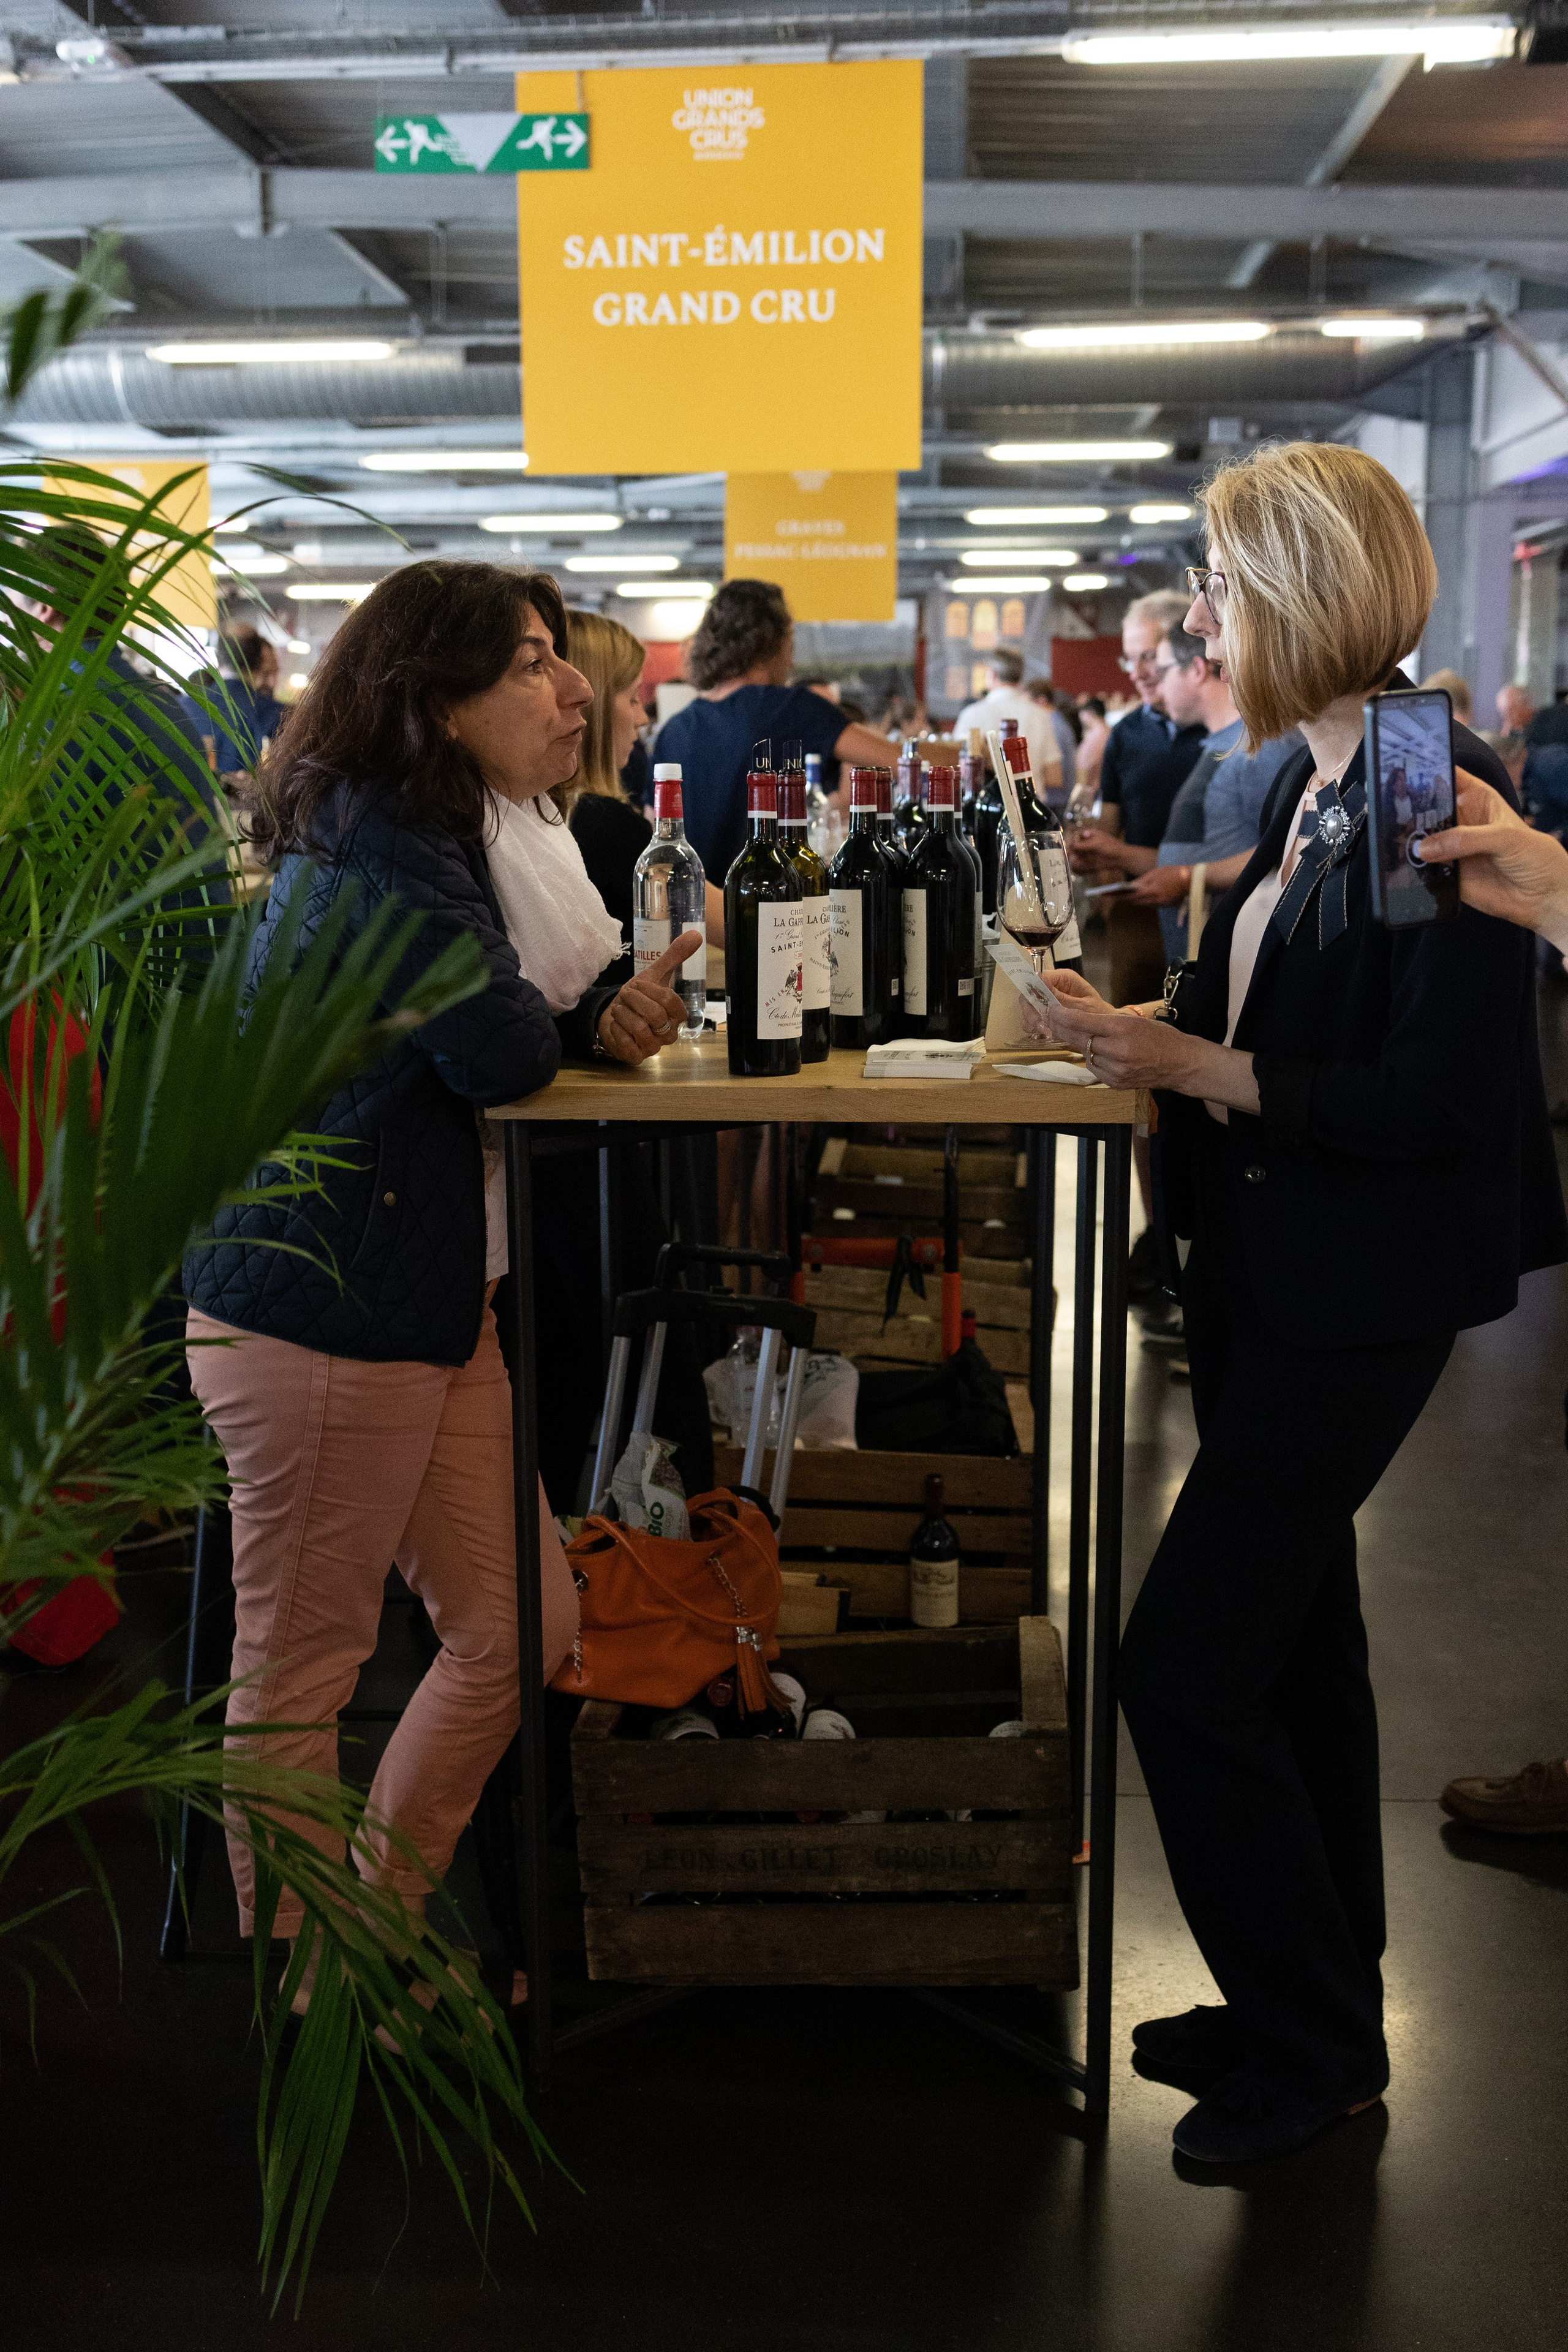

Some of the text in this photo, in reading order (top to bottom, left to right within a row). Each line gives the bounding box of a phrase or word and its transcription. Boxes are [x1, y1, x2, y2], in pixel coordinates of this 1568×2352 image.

[683, 87, 753, 108] UNION
[671, 107, 766, 131] GRANDS
[689, 129, 748, 150] CRUS
[563, 224, 884, 269] SAINT-ÉMILION
[592, 288, 835, 326] GRAND CRU
[774, 918, 785, 927] LA
[807, 915, 818, 924] LA
[765, 997, 776, 1008] MIS
